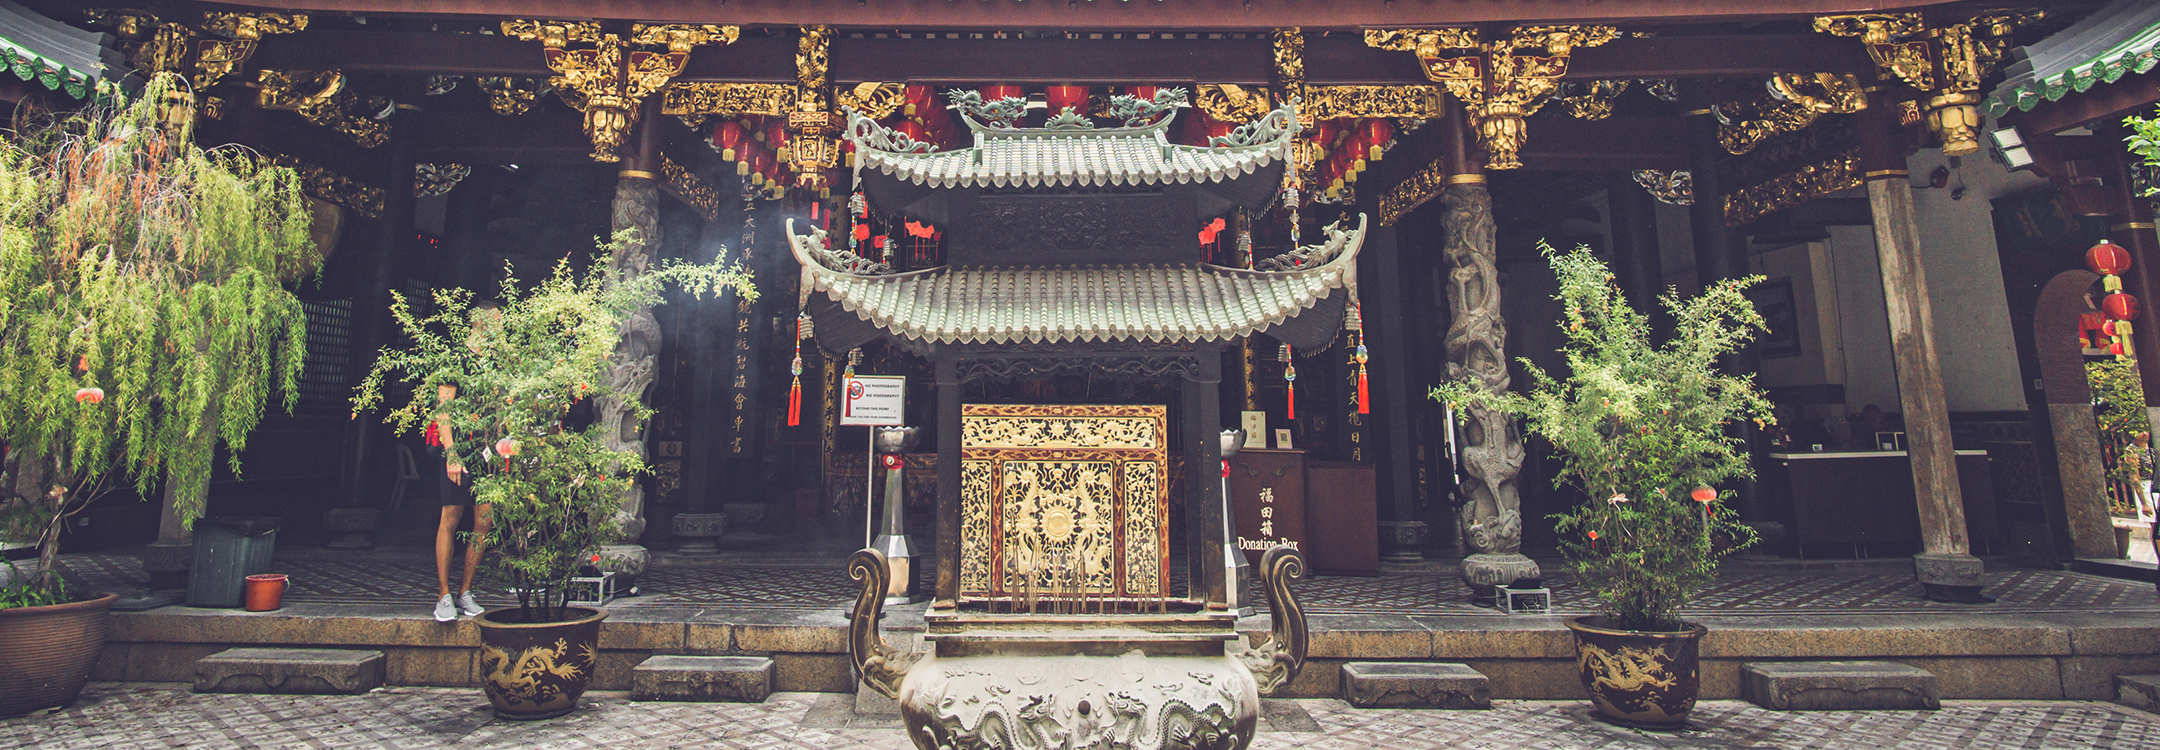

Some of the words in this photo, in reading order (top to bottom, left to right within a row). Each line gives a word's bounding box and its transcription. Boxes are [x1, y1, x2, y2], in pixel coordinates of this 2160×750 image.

[1259, 487, 1274, 537] 福田箱
[1238, 536, 1277, 550] Donation
[1281, 537, 1299, 551] Box
